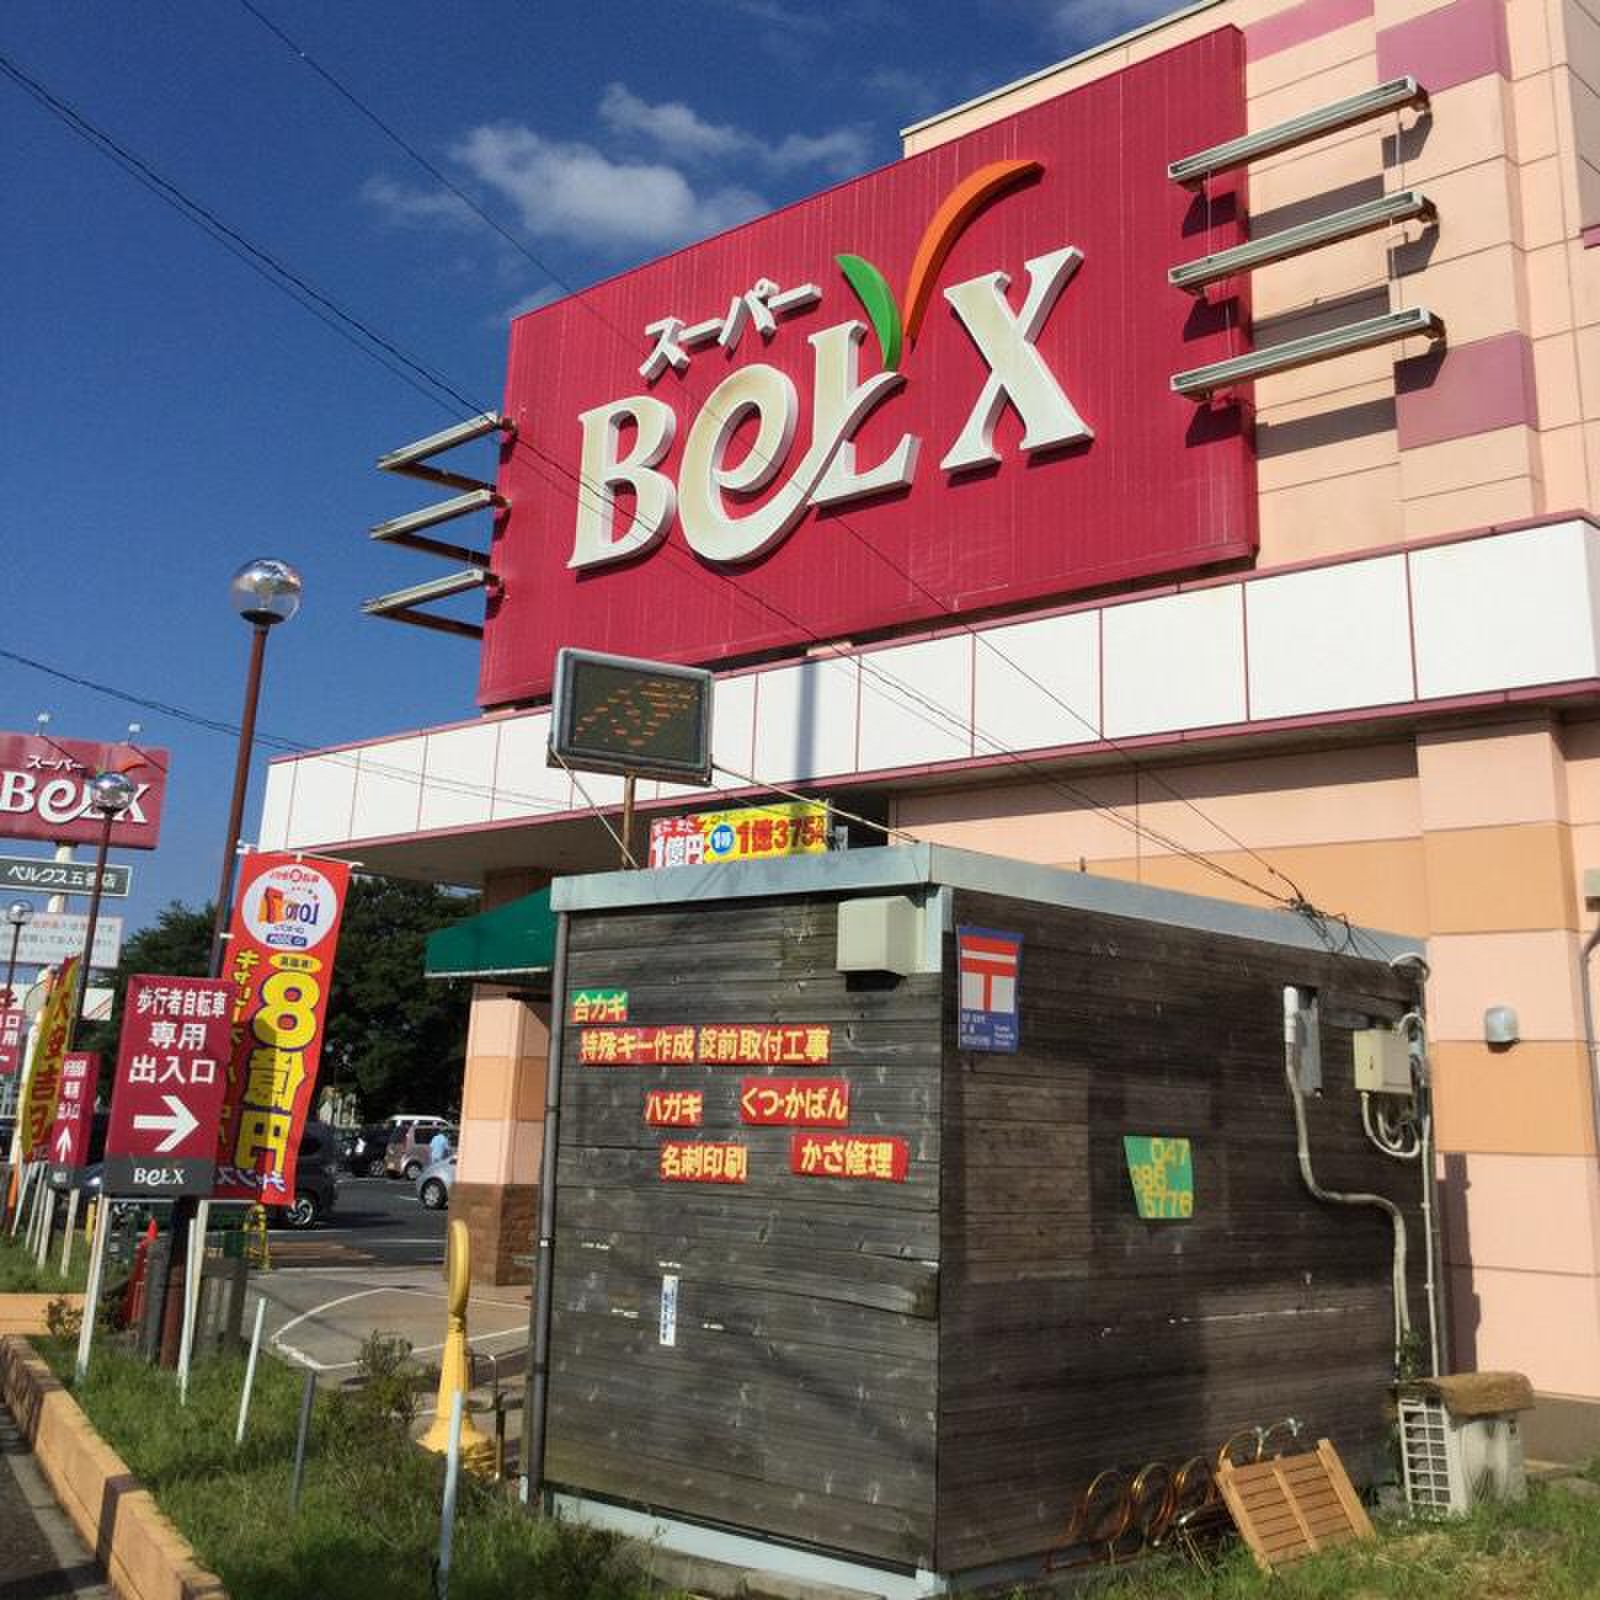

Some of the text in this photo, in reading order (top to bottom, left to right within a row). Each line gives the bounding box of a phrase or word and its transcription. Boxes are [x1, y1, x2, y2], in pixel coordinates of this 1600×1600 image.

[639, 277, 822, 383] スーパー
[137, 986, 228, 1018] 歩行者自転車
[573, 992, 628, 1023] 合カギ
[148, 1022, 207, 1051] 専用
[580, 1029, 695, 1061] 特殊キー作成
[128, 1054, 217, 1085] 出入口
[645, 1094, 703, 1122] ハガキ
[661, 1145, 748, 1179] 名刺印刷
[801, 1139, 893, 1178] かさ修理
